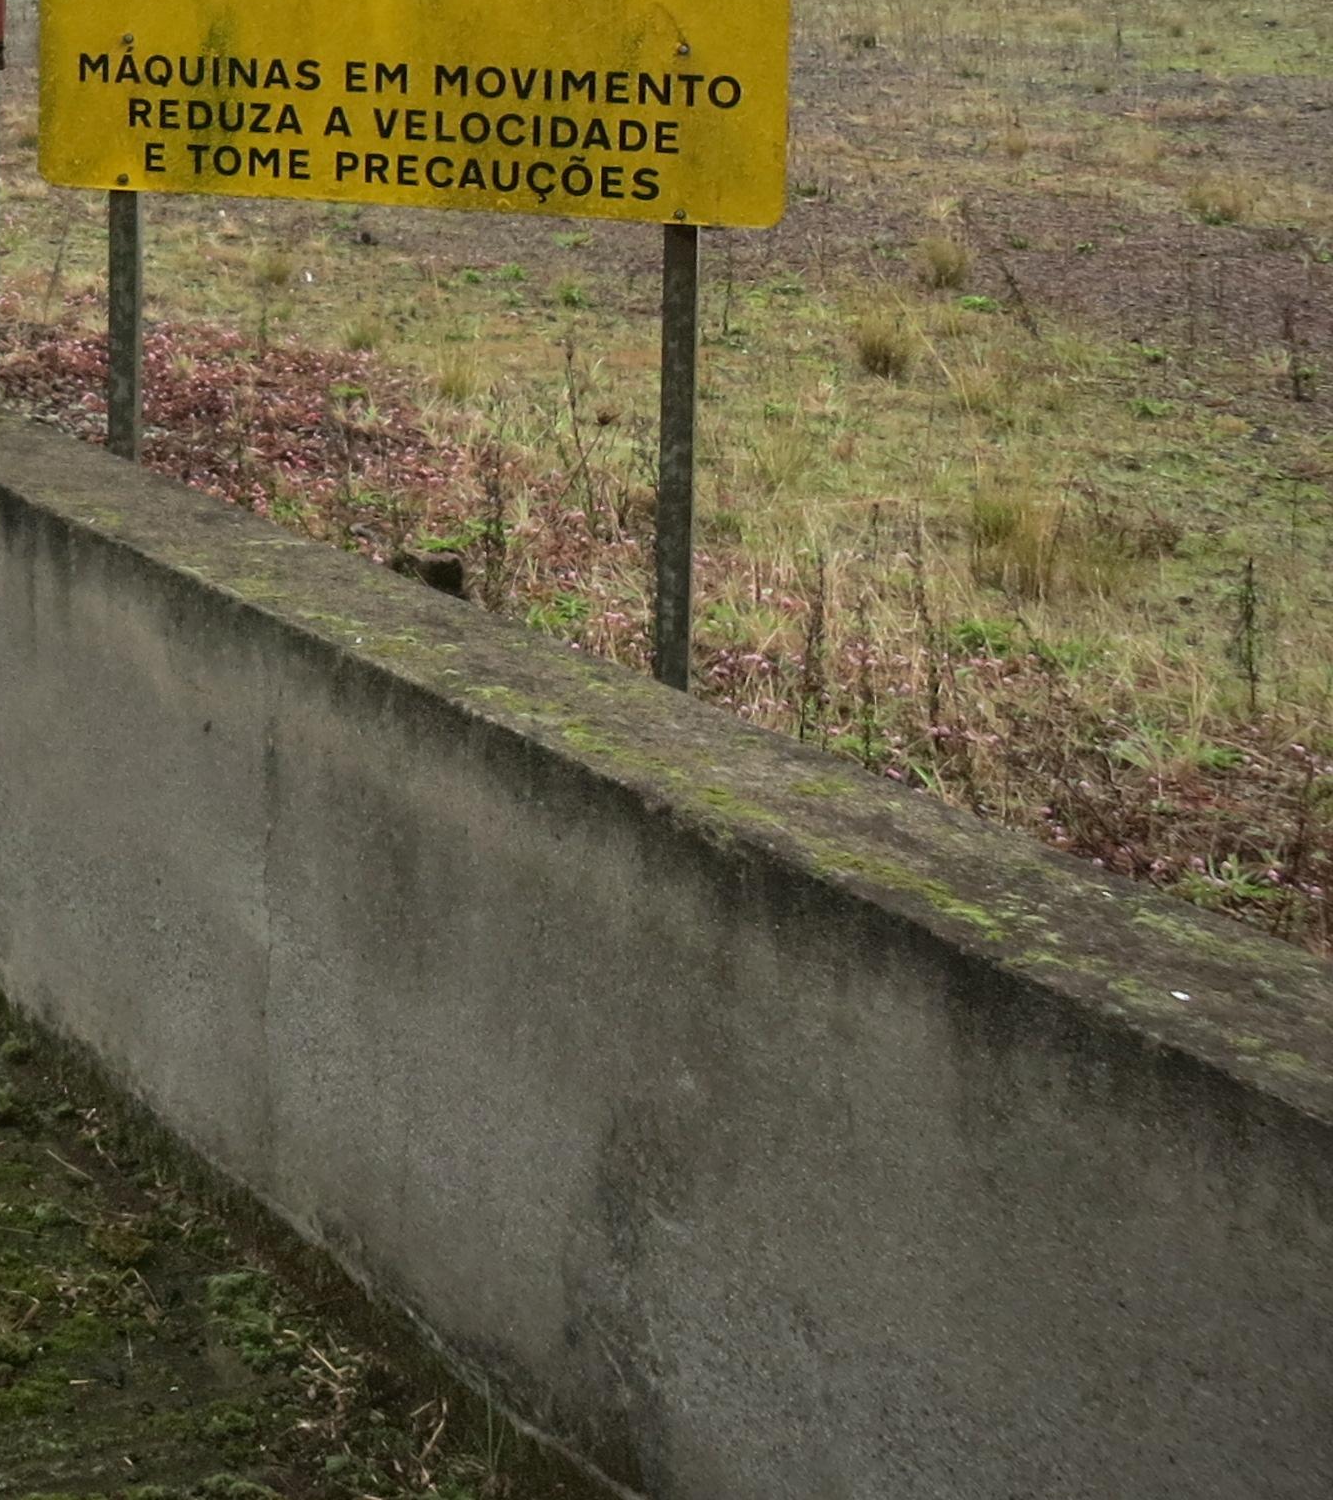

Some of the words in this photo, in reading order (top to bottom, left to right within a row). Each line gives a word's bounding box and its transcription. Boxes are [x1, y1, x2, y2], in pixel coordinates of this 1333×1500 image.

[79, 47, 321, 91] MÁQUINAS
[345, 62, 409, 95] EM
[433, 64, 743, 109] MOVIMENTO
[130, 98, 303, 134] REDUZA
[323, 106, 353, 138] A
[374, 109, 680, 155] VELOCIDADE
[145, 142, 167, 173] E
[187, 145, 311, 180] TOME
[335, 152, 660, 203] PRECAUÇÕES
